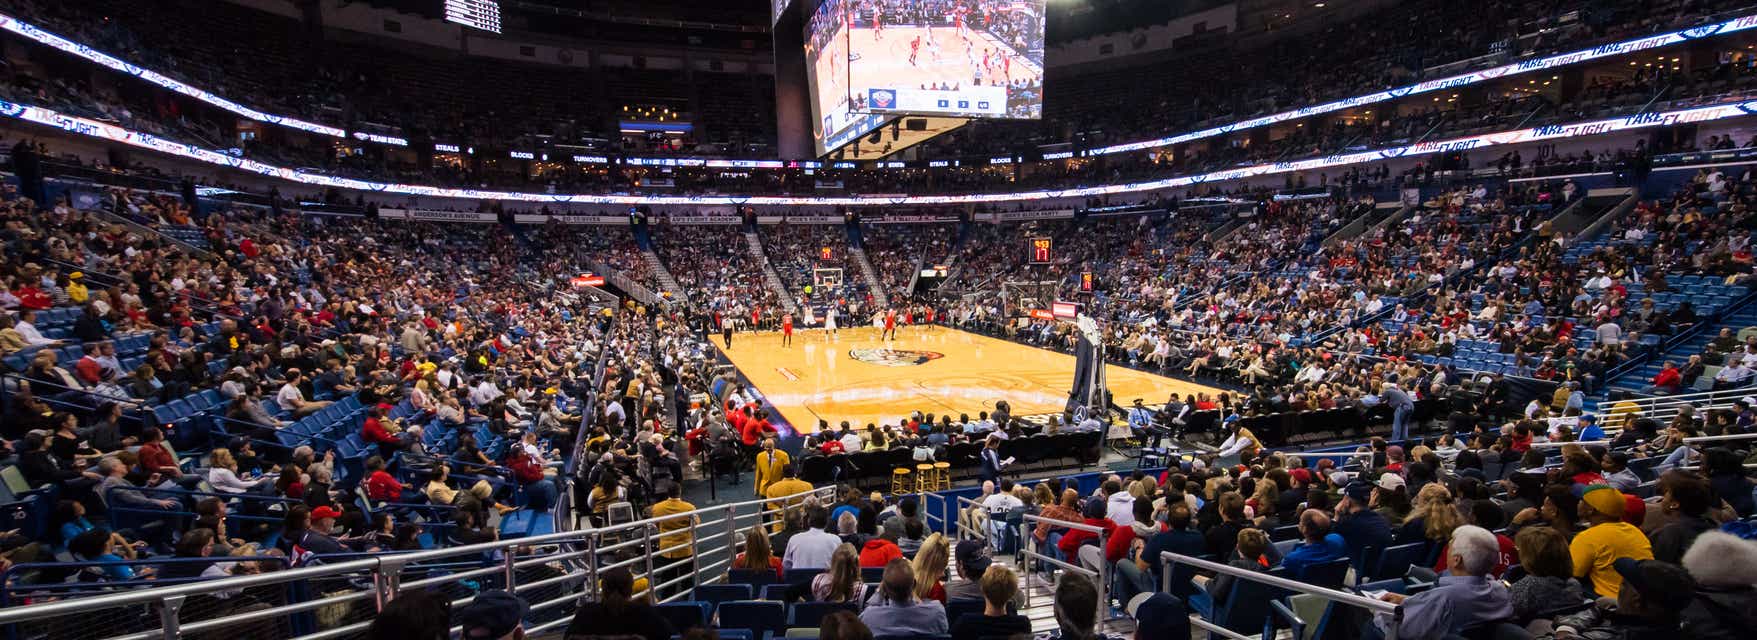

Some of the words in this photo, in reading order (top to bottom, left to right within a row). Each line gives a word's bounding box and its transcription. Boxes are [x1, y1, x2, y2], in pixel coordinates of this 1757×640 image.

[435, 144, 460, 152] STEALS
[510, 151, 534, 159] BLOCKS
[1043, 152, 1073, 160] TURNOVERS
[1036, 248, 1048, 261] 17
